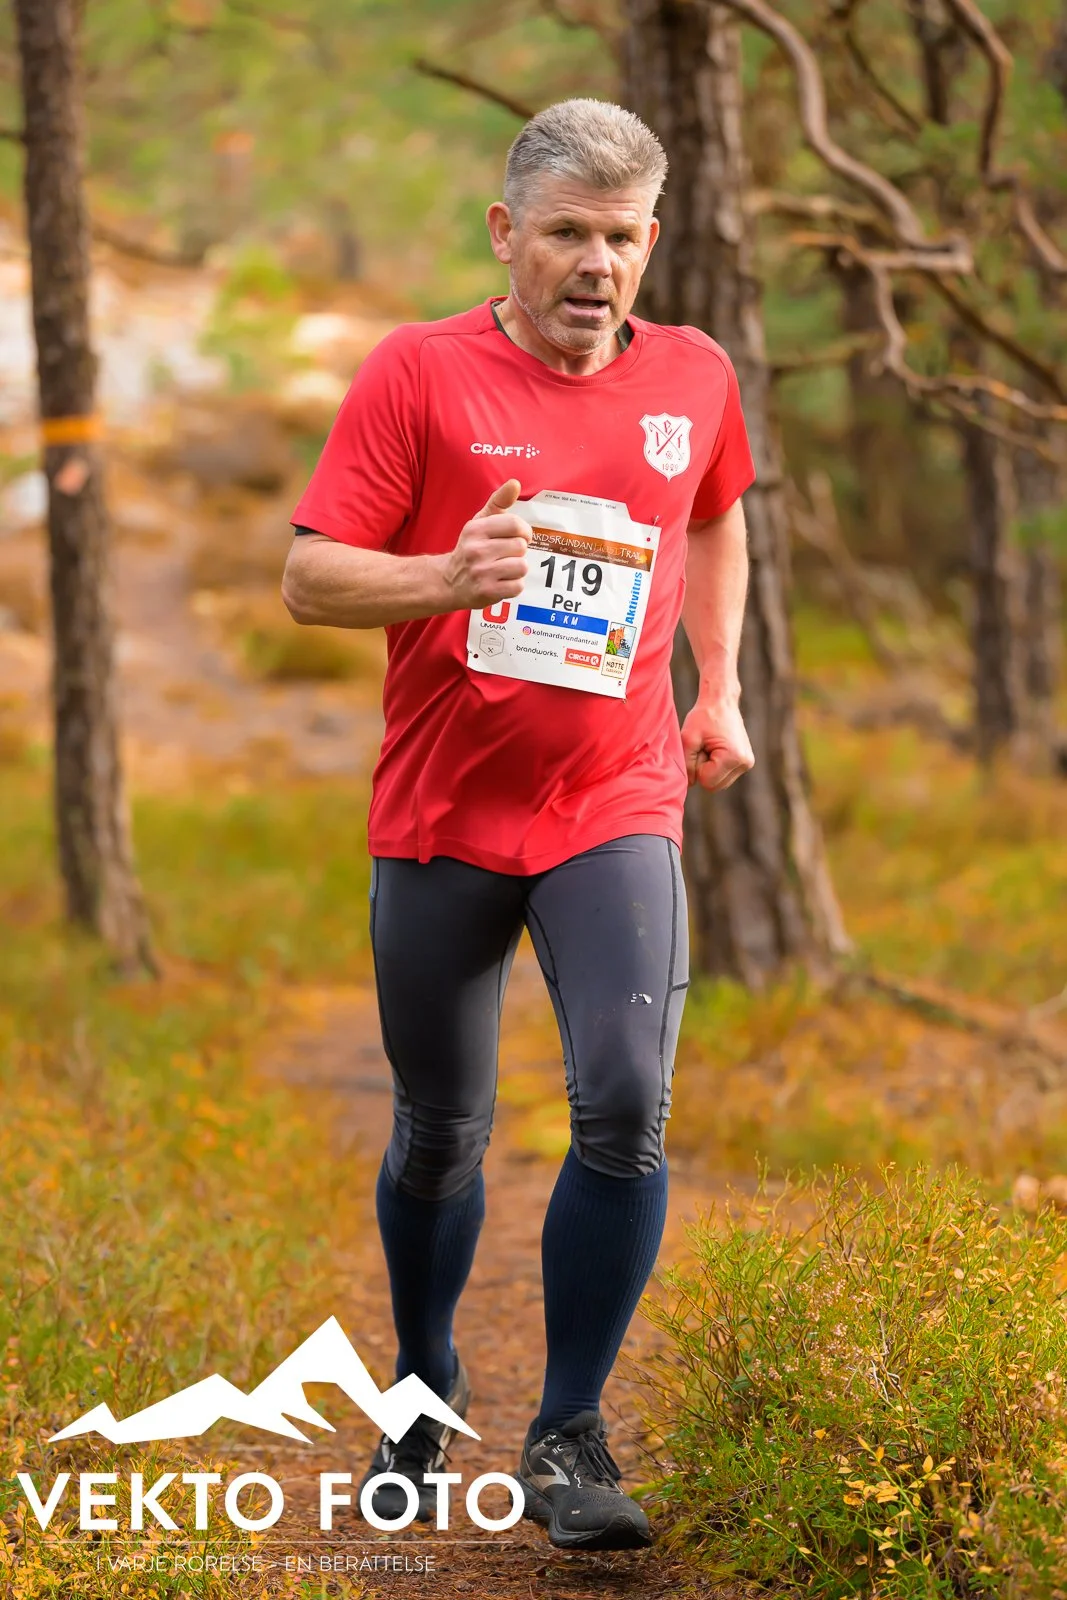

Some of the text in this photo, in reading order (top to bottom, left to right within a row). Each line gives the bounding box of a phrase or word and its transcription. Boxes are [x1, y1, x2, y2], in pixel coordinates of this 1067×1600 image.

[470, 443, 524, 457] CRAFT
[540, 556, 603, 597] 119
[552, 594, 582, 613] Per
[625, 572, 643, 625] Aktivitus
[550, 613, 556, 622] 6
[480, 622, 507, 632] UMARA
[532, 628, 599, 646] kolmardsrundantrail
[567, 652, 590, 663] CIRCLE
